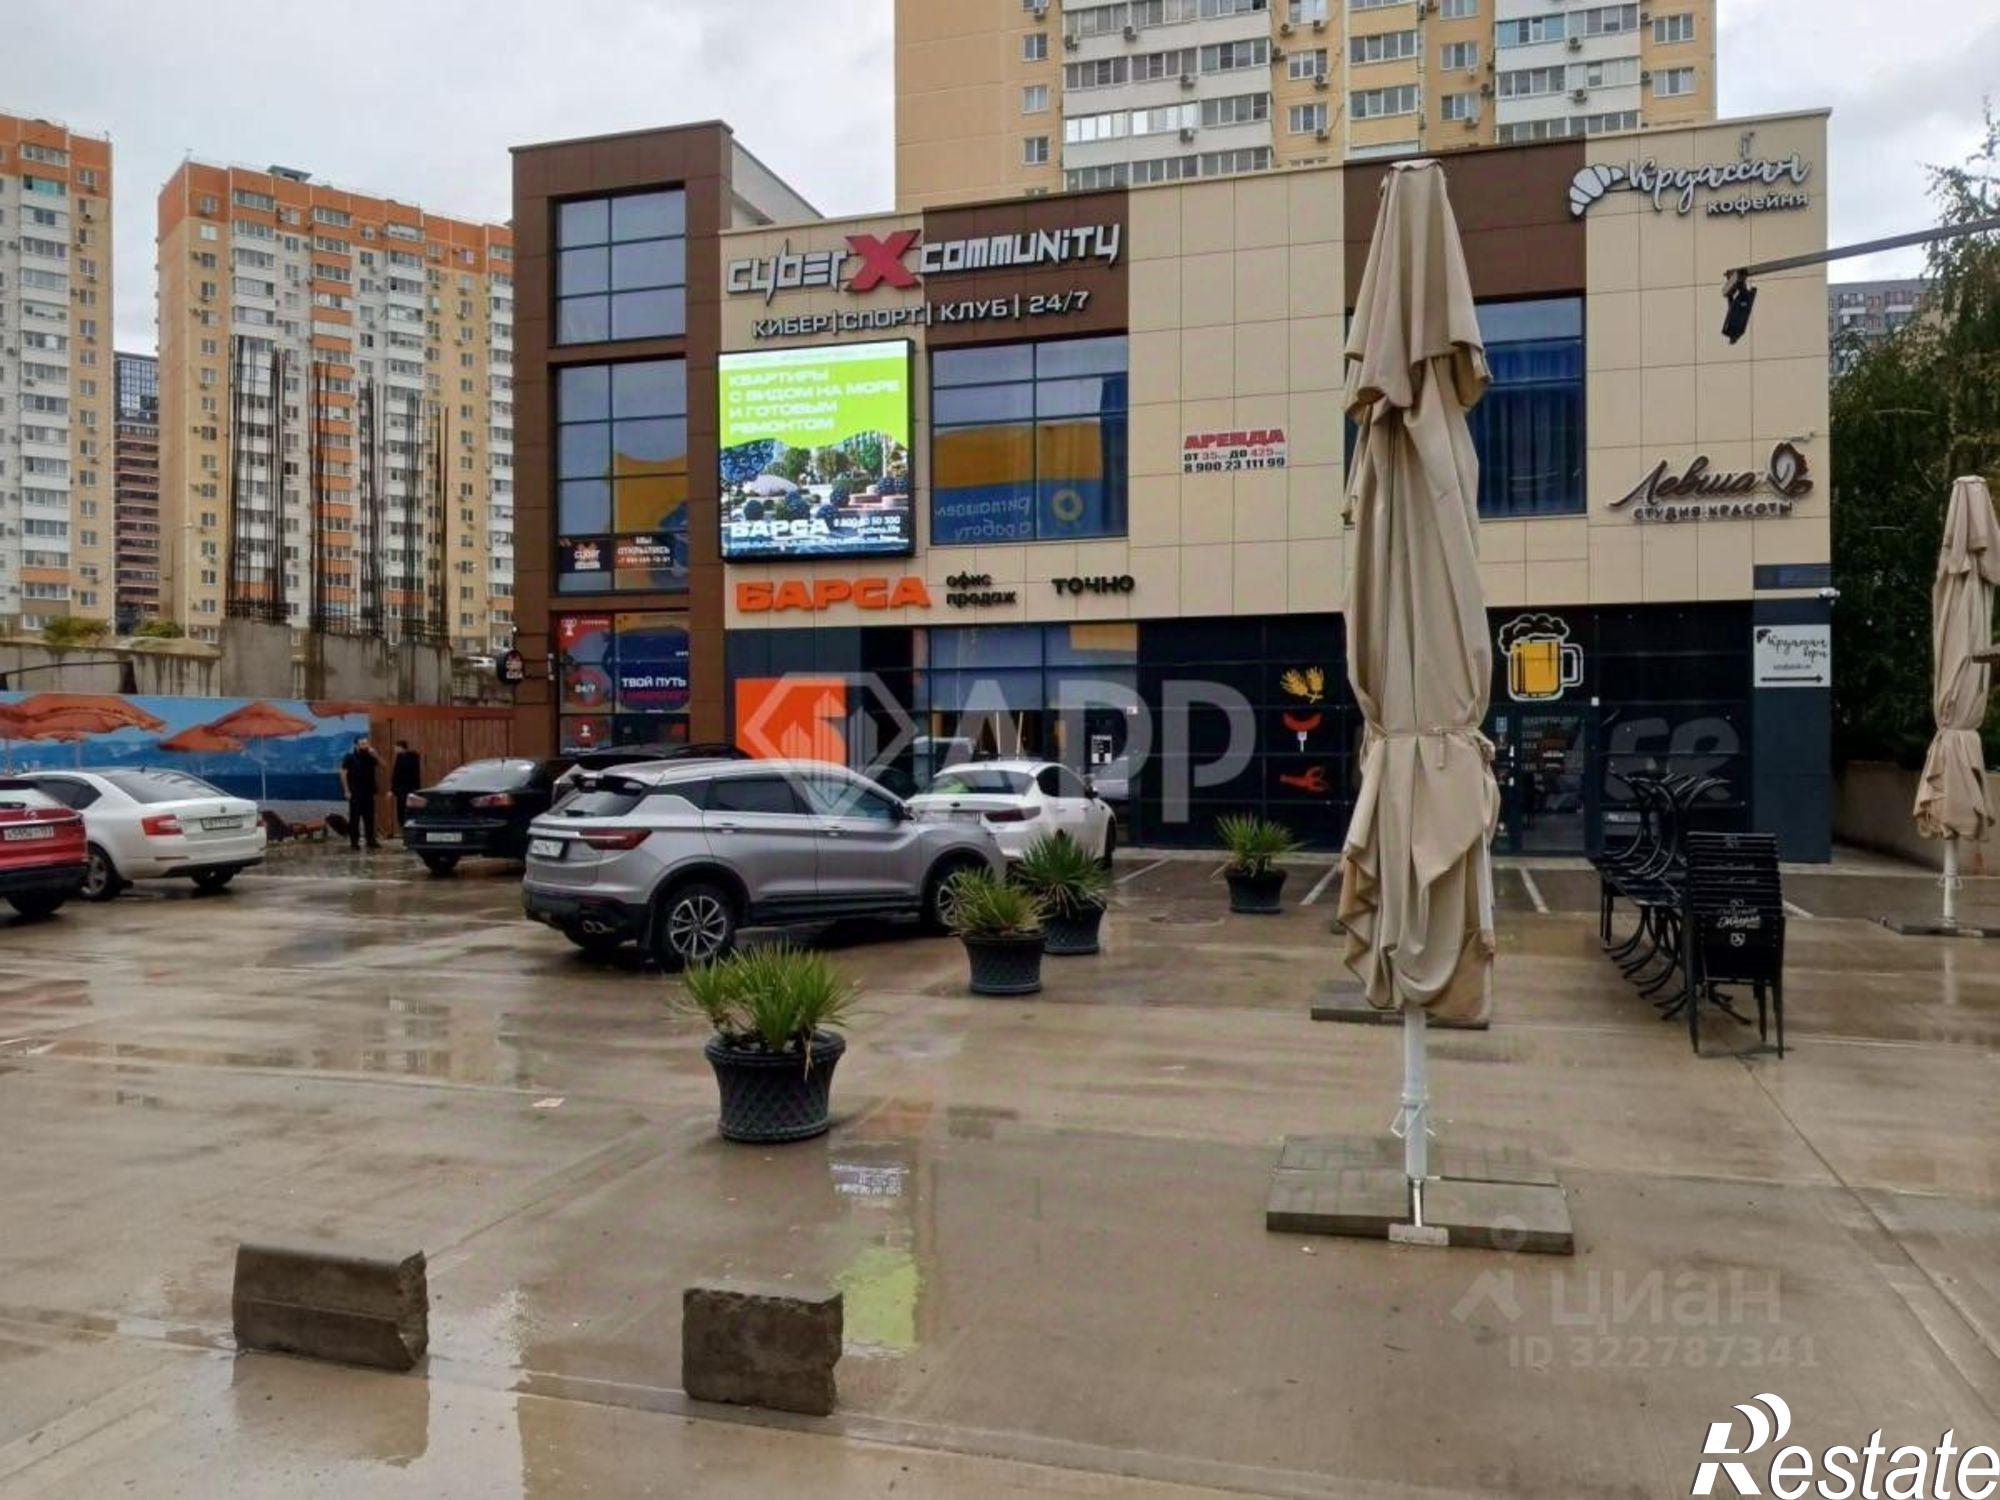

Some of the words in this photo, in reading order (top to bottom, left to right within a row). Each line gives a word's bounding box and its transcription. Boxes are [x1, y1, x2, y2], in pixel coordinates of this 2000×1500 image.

[1629, 153, 1813, 217] Круассан
[1029, 291, 1091, 314] 24/7
[1184, 429, 1285, 449] АРЕНДА
[736, 577, 932, 613] БАРСА
